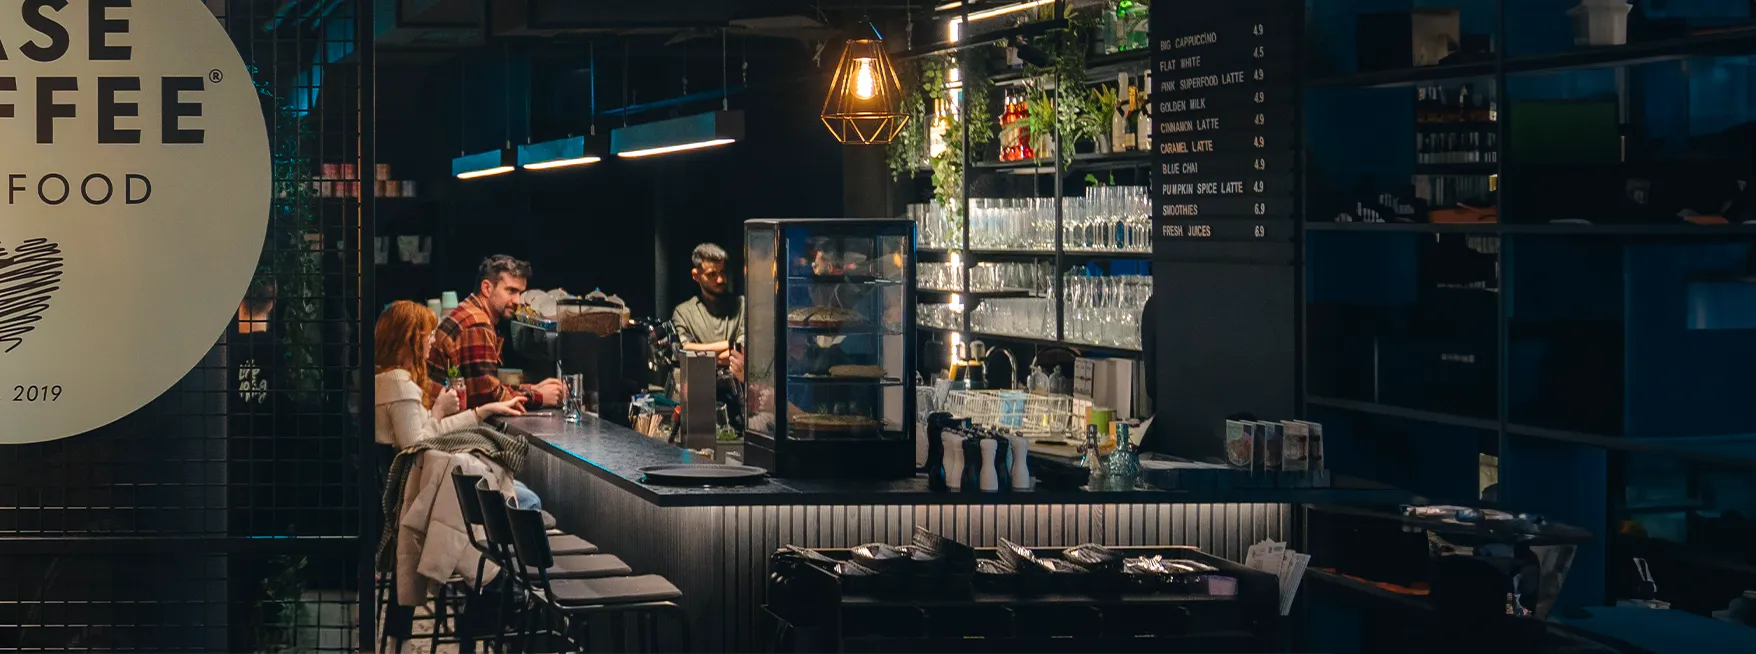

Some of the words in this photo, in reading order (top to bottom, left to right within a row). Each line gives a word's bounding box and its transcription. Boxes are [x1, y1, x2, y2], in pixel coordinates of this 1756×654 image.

[0, 0, 133, 61] SE
[1160, 40, 1171, 51] BIG
[1175, 32, 1217, 49] CAPPUCCINO
[1253, 23, 1264, 36] 4.9
[1160, 60, 1176, 72] FLAT
[1180, 56, 1201, 68] WHITE
[1253, 46, 1264, 58] 4.5
[1180, 75, 1219, 90] SUPERFOOD
[1221, 71, 1244, 85] LATTE
[1253, 69, 1264, 80] 4.9
[1160, 100, 1186, 113] GOLDEN
[1190, 98, 1206, 110] MILK
[1254, 92, 1265, 103] 4.9
[1160, 121, 1193, 133] CINNAMON
[1196, 118, 1219, 131] LATTE
[1254, 113, 1265, 125] 4.9
[1160, 141, 1189, 154] CARAMEL
[1191, 140, 1213, 152] LATTE
[1253, 136, 1265, 147] 4.9
[1162, 163, 1180, 174] BLUE
[1182, 162, 1198, 173] CHAI
[1254, 158, 1265, 170] 4.9
[8, 173, 152, 205] FOOD
[1162, 183, 1194, 195] PUMPKIN
[1196, 182, 1217, 194] SPICE
[1221, 181, 1243, 194] LATTE
[1253, 181, 1264, 192] 4.9
[1162, 204, 1198, 216] SMOOTHIES
[1254, 203, 1265, 215] 6.9
[1162, 225, 1183, 236] FRESH
[1188, 225, 1211, 237] JUICES
[1254, 225, 1265, 237] 6.9
[12, 385, 63, 401] 2019
